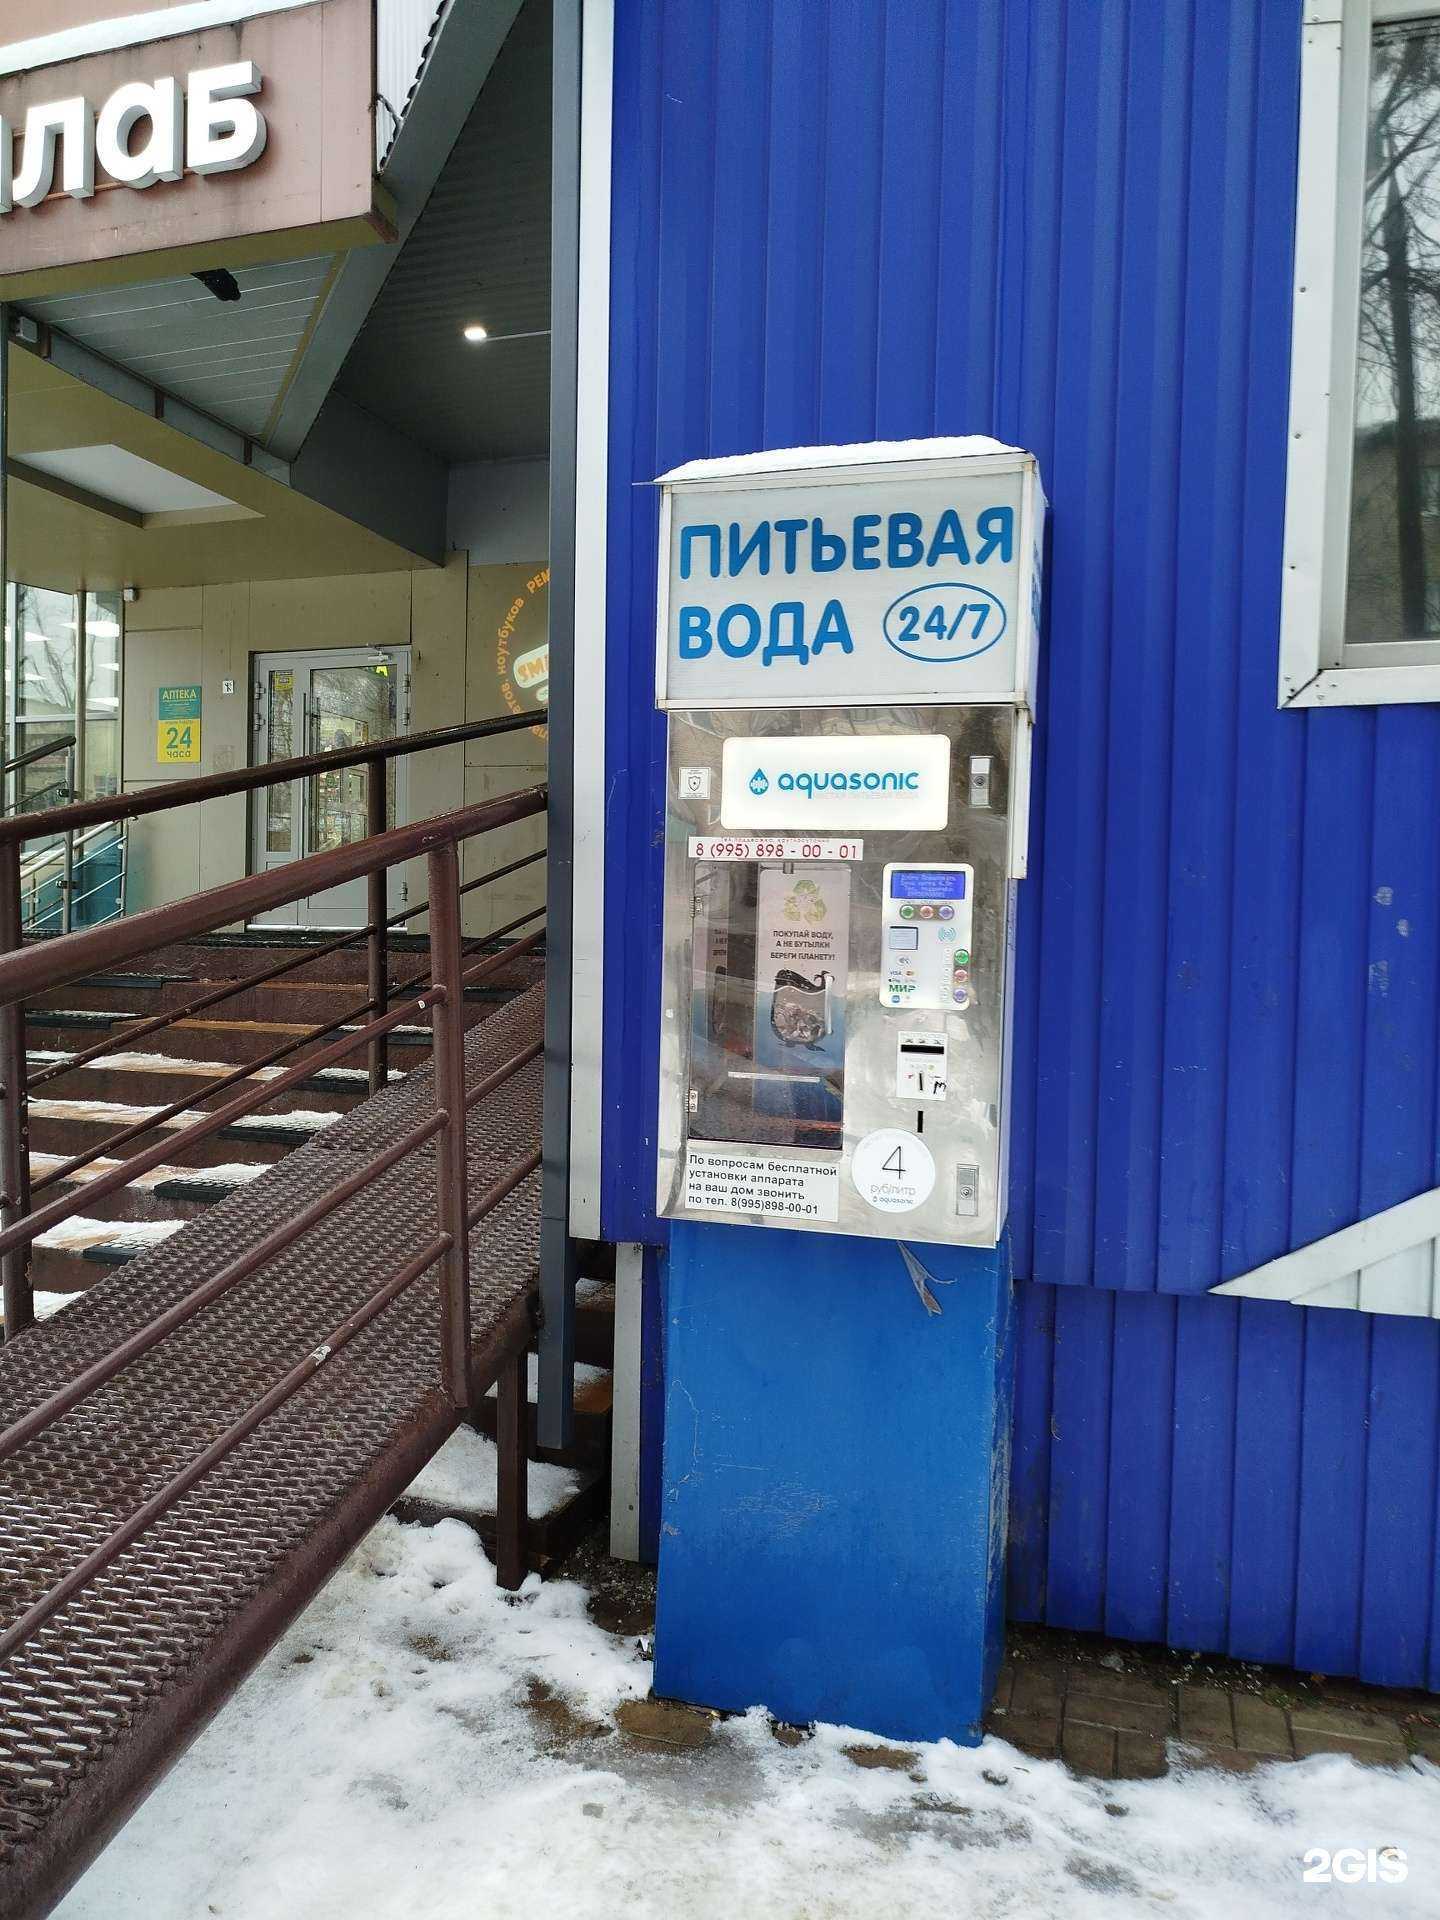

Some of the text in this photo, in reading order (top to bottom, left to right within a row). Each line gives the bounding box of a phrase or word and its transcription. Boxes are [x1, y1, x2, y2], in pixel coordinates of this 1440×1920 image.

[680, 506, 1014, 580] ПИТЬЕВАЯ
[679, 599, 991, 667] ВОДА 24/7
[162, 688, 197, 700] АПТЕКА
[166, 726, 193, 749] 24
[166, 750, 192, 758] часа
[777, 771, 920, 800] aquasonic
[696, 843, 704, 857] 8
[710, 843, 749, 858] (995)
[756, 844, 785, 858] 898
[802, 844, 822, 859] 00
[839, 845, 857, 860] 01
[773, 930, 810, 938] ПОКУПАЙ
[783, 940, 793, 948] НЕ
[794, 940, 830, 949] БУТЫЛКИ
[770, 952, 835, 961] БЕРЕГИ ПЛАНЕТУ!
[888, 984, 916, 993] МИР
[689, 1154, 837, 1176] По вопросам бесплатной
[882, 1145, 906, 1180] 4
[689, 1169, 804, 1187] установки аппарата
[688, 1182, 805, 1200] на ваш дом звонить
[688, 1195, 818, 1214] по тел. 8(995)898-00-01
